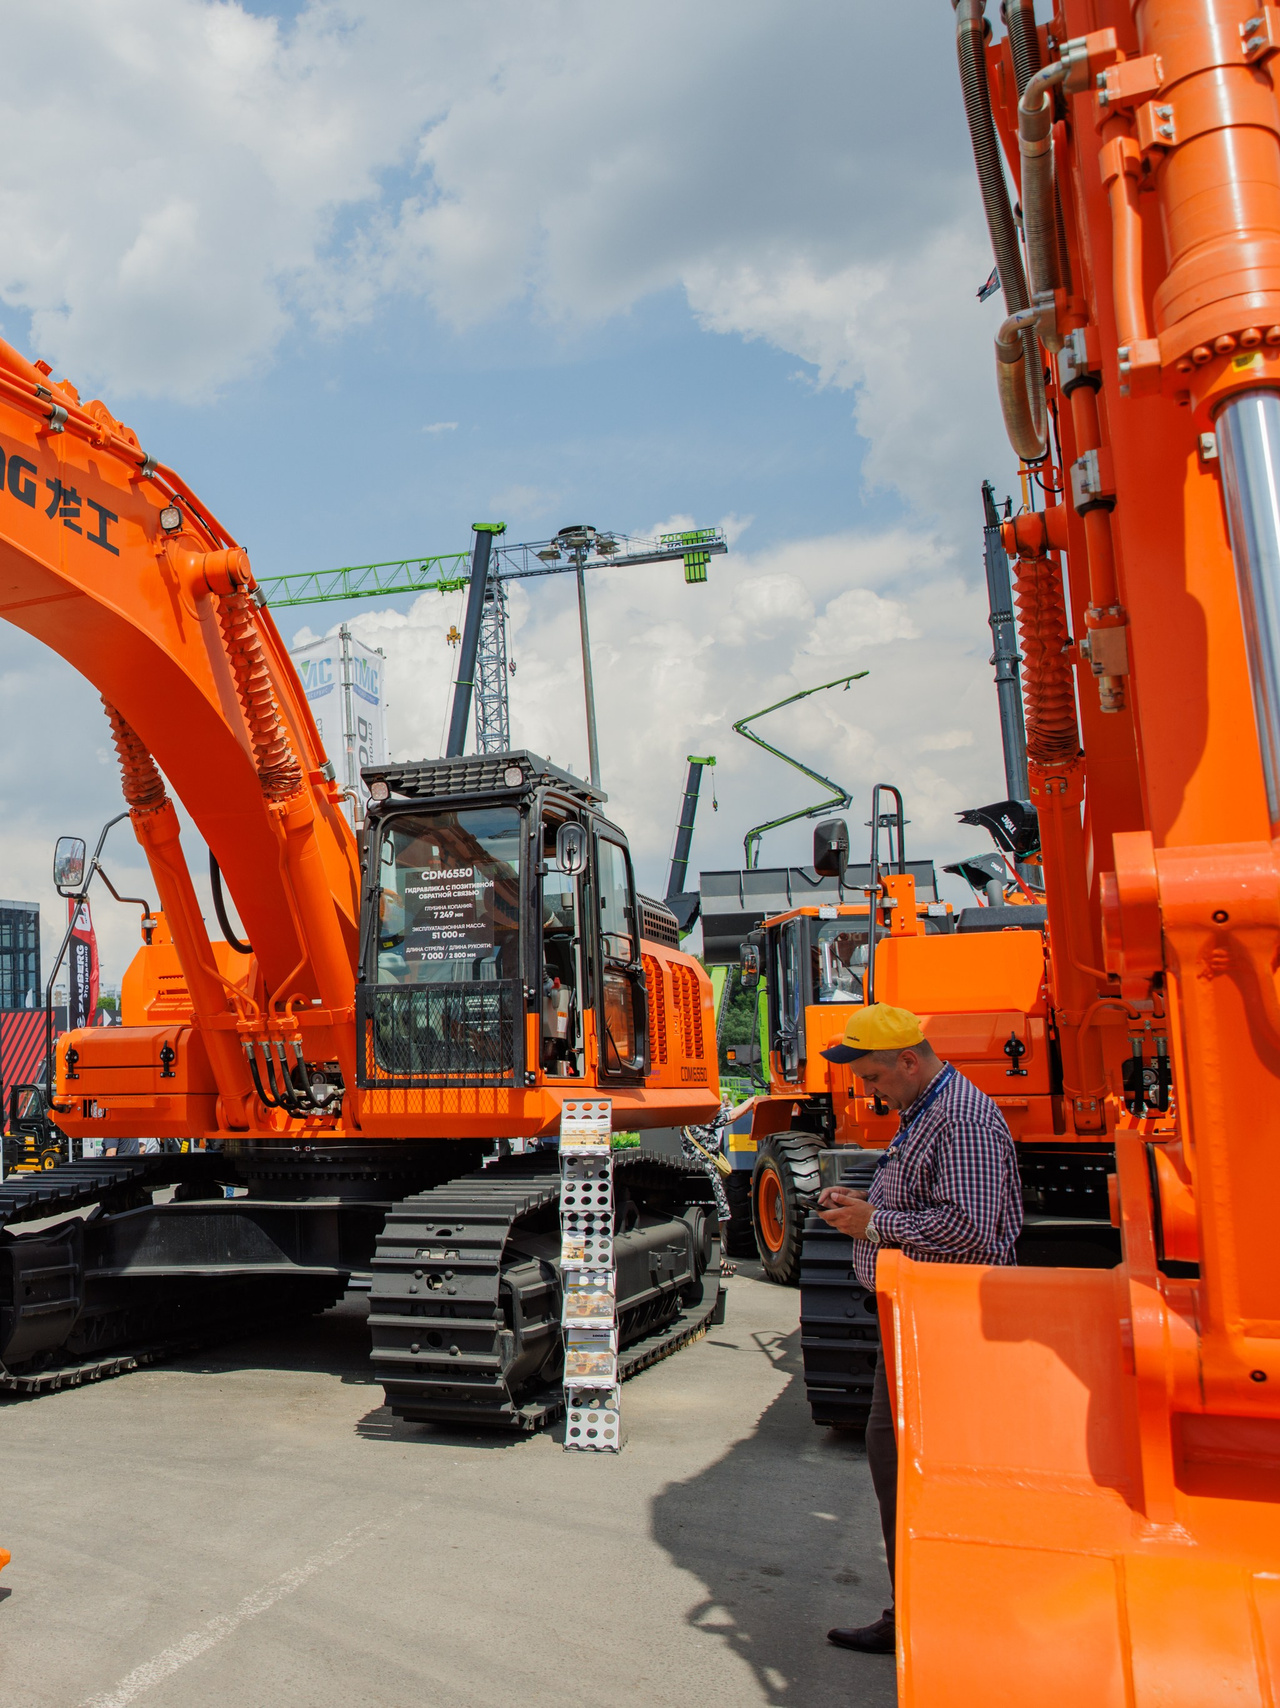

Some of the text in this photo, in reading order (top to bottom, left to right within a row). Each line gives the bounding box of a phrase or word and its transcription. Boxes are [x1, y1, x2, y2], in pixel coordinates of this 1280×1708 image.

[421, 867, 473, 880] CDM6550
[405, 885, 445, 894] ГИДРАВЛИКА
[451, 881, 494, 890] ПОЗИТИВНОЙ
[418, 889, 480, 900] ОБРАТНОЙ СВЯЗЬЮ
[439, 911, 454, 919] 249
[441, 931, 458, 939] 000
[76, 944, 85, 1013] ZAUBERG
